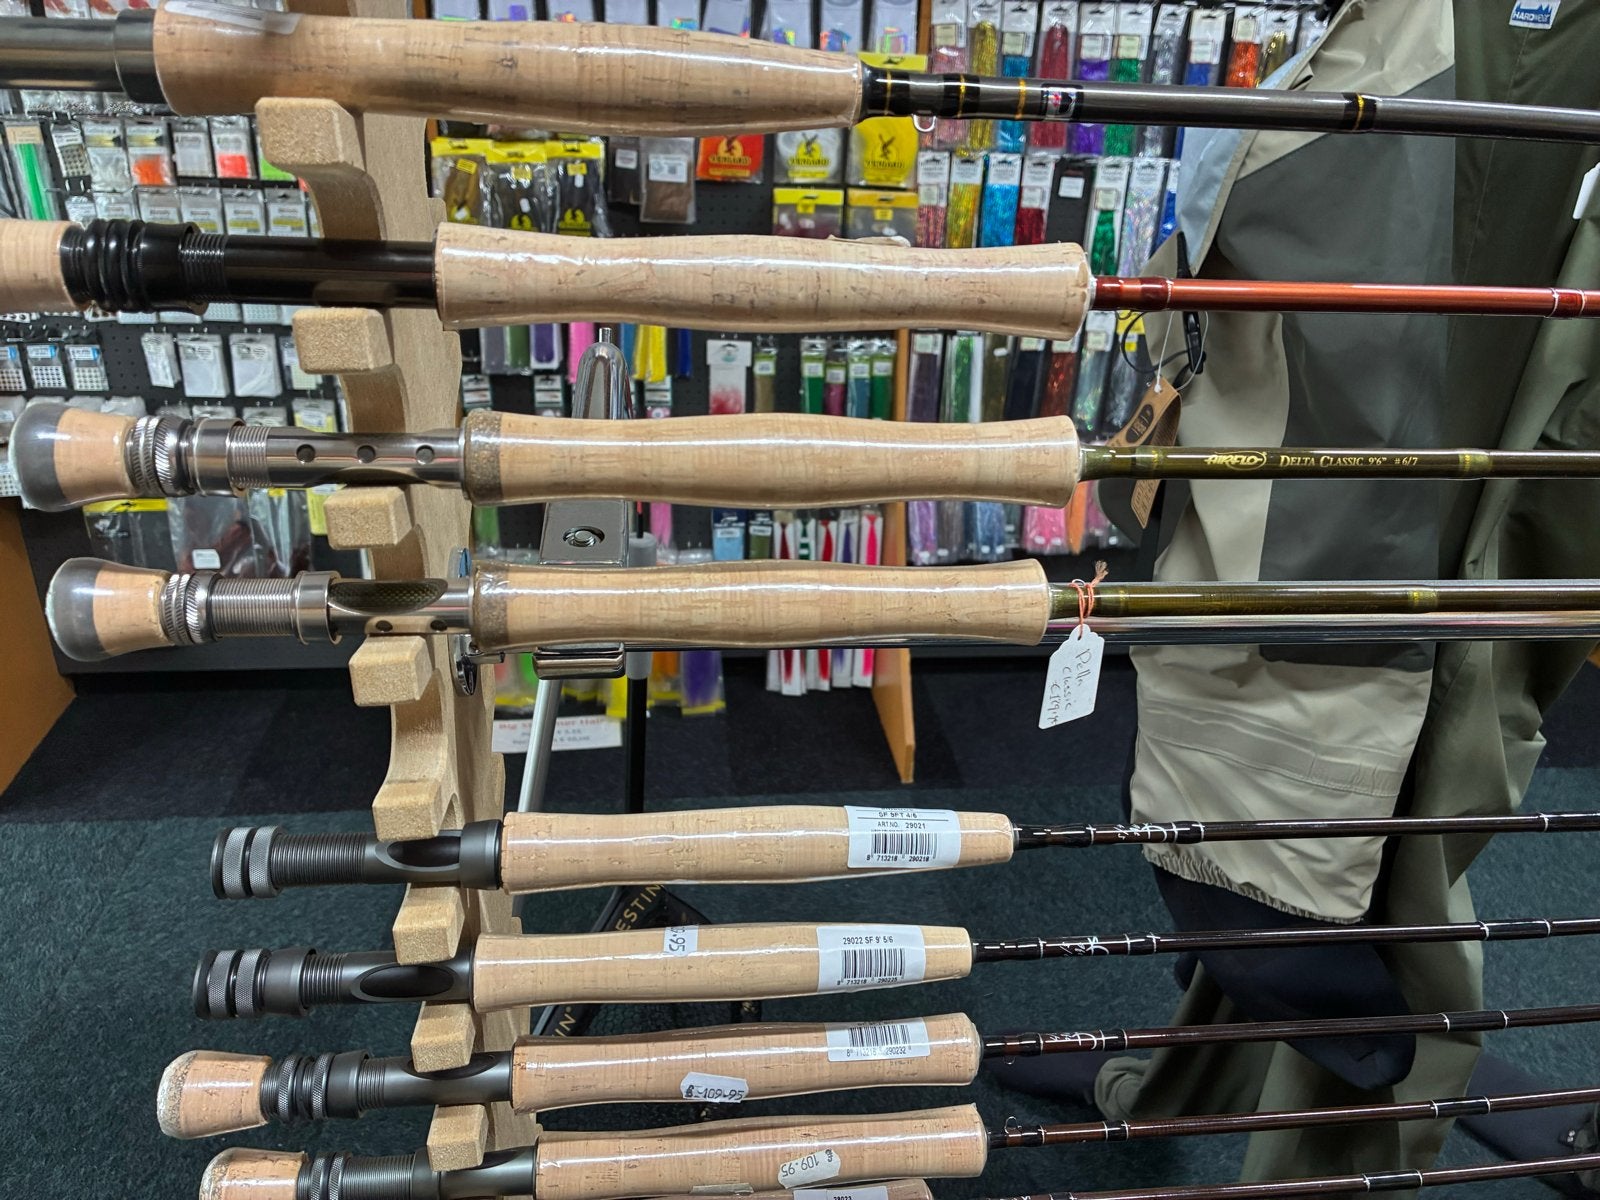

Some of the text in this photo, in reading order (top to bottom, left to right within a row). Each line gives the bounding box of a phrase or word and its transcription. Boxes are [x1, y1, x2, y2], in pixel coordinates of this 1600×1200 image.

[1204, 451, 1267, 469] AIRFLO
[905, 822, 926, 830] 29021
[843, 936, 863, 945] 29022
[864, 936, 873, 944] SF
[885, 1046, 906, 1056] 290232
[781, 1154, 820, 1178] 109.95
